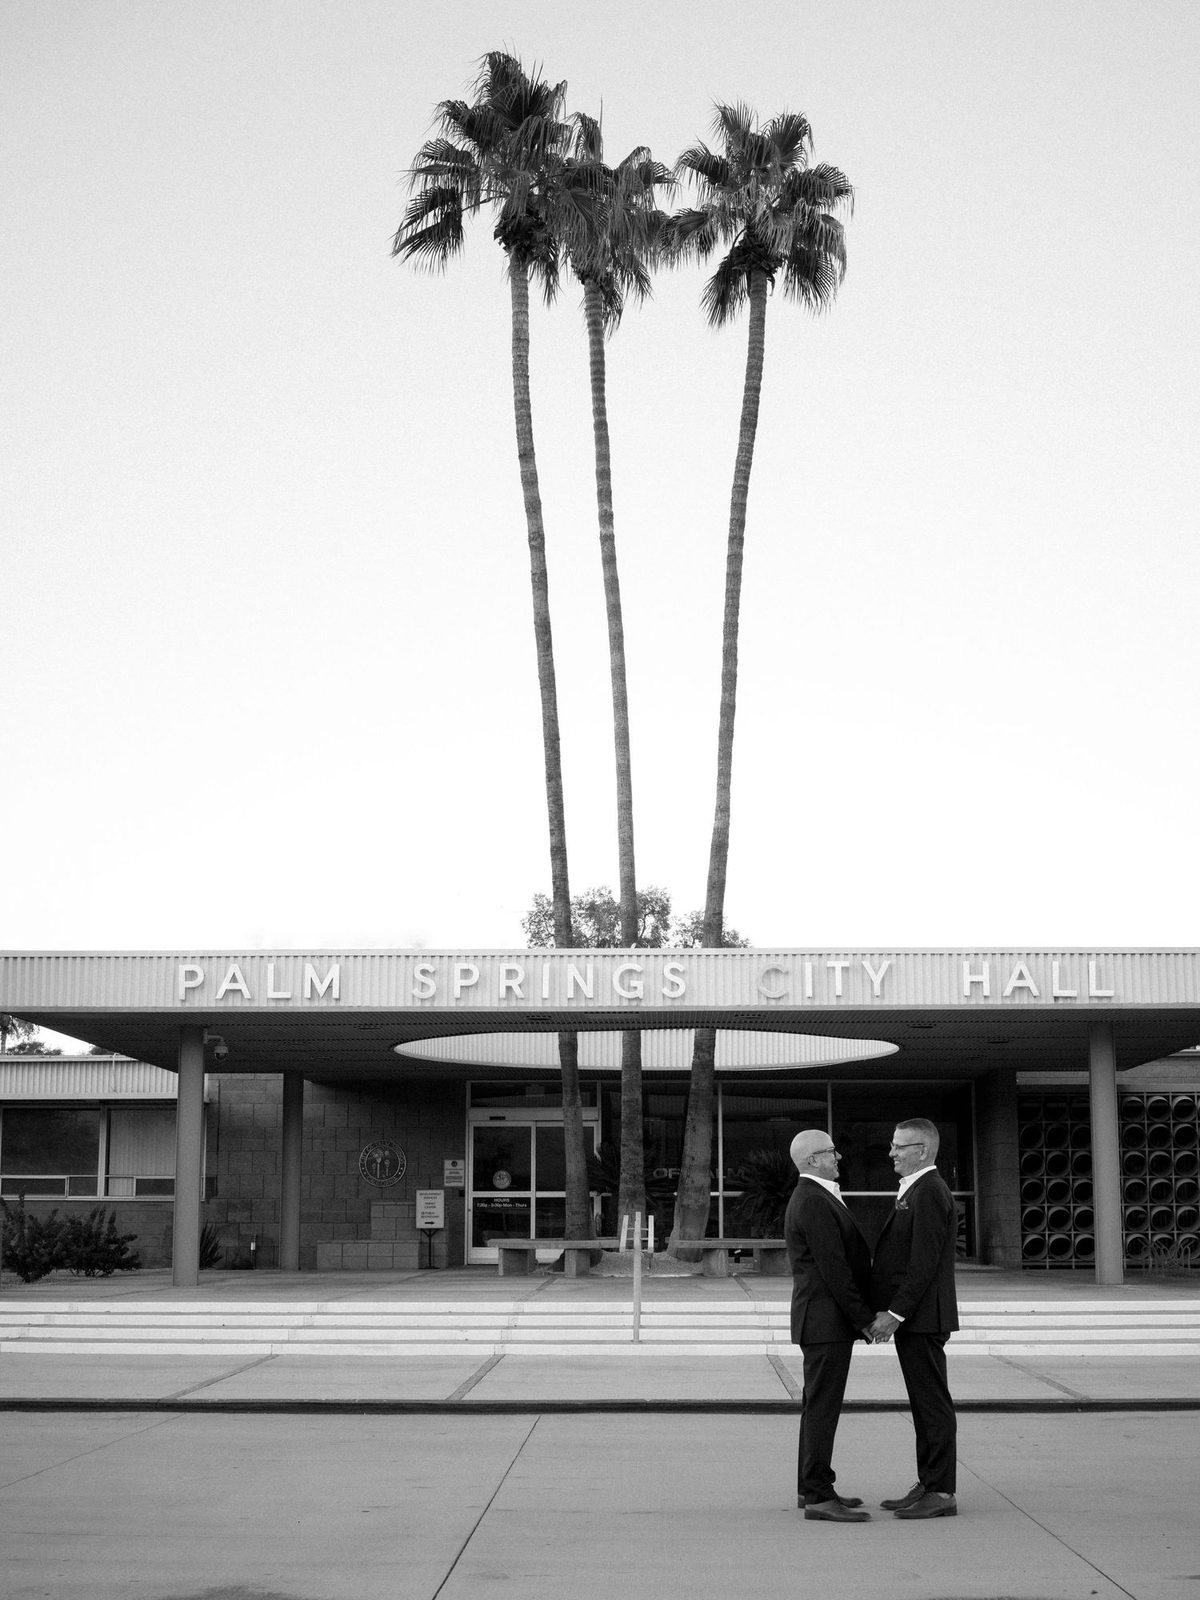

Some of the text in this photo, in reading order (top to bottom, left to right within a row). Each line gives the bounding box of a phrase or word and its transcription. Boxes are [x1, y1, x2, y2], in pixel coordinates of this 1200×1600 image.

[178, 960, 1115, 1000] PALM SPRINGS CITY HALL
[653, 1168, 680, 1179] OF
